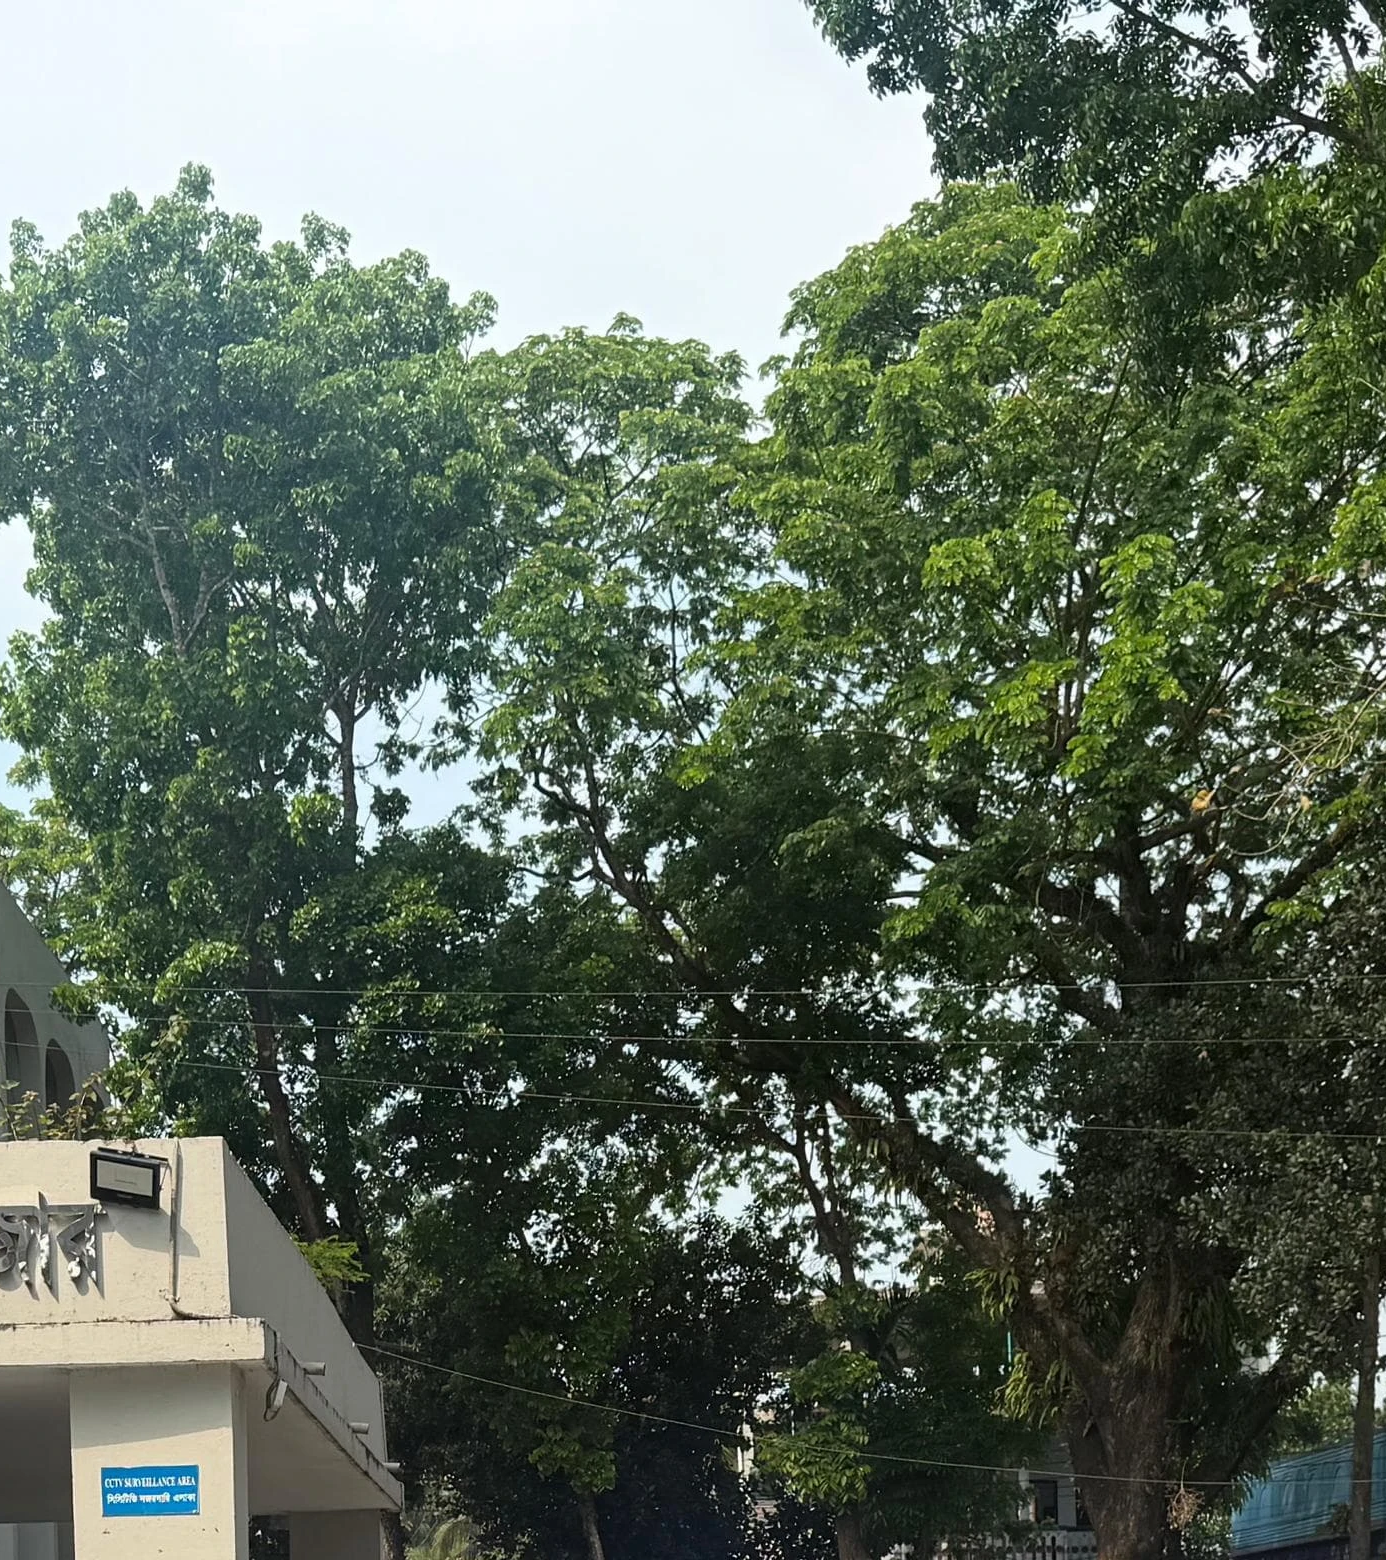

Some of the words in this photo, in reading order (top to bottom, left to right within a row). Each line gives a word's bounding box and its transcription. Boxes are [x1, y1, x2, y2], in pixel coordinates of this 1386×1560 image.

[104, 1478, 124, 1488] CCTV
[124, 1476, 175, 1488] SURVEILLANCE
[177, 1475, 196, 1486] AREA
